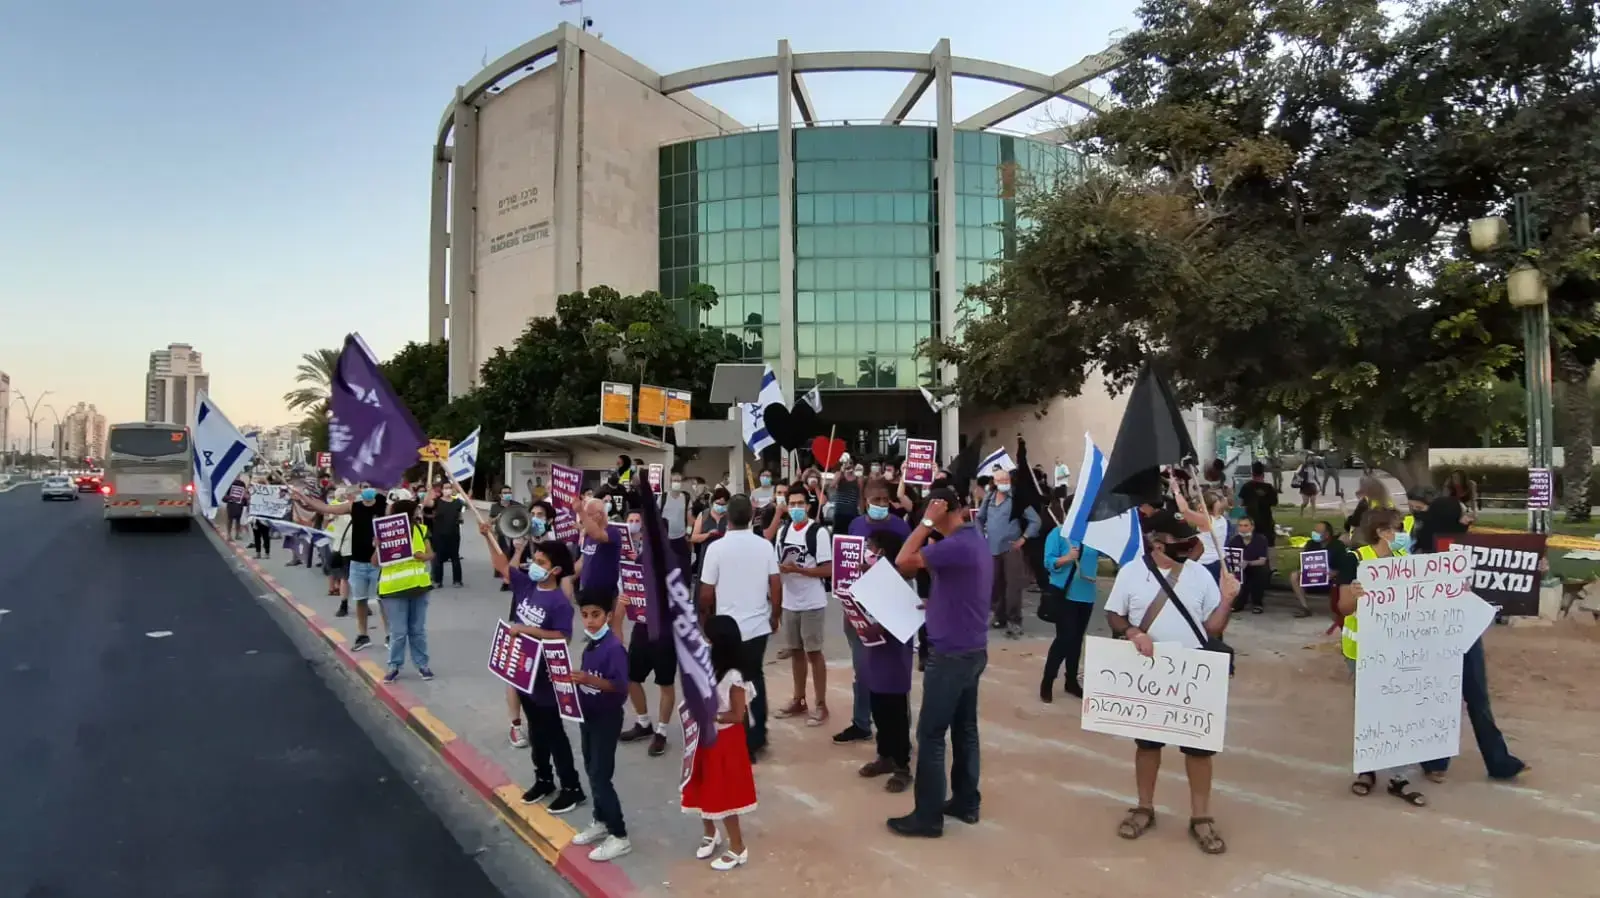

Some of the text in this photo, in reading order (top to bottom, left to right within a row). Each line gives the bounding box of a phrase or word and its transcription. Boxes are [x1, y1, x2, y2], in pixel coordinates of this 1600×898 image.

[553, 468, 579, 482] בריאות
[553, 479, 576, 493] פרנסה
[378, 519, 405, 530] בריאות
[380, 528, 405, 538] פרנסה
[380, 538, 408, 550] תקווה
[840, 541, 860, 550] ביטחון
[842, 550, 860, 559] כלכלי
[621, 567, 644, 579] בריאות
[1363, 586, 1396, 617] הפקר
[491, 628, 505, 668] בריאות
[498, 634, 512, 671] פרנסה
[506, 637, 523, 679] תקווה
[1142, 655, 1211, 682] תודה
[1100, 668, 1198, 705] למשטרה
[1163, 712, 1214, 734] לחיזוק
